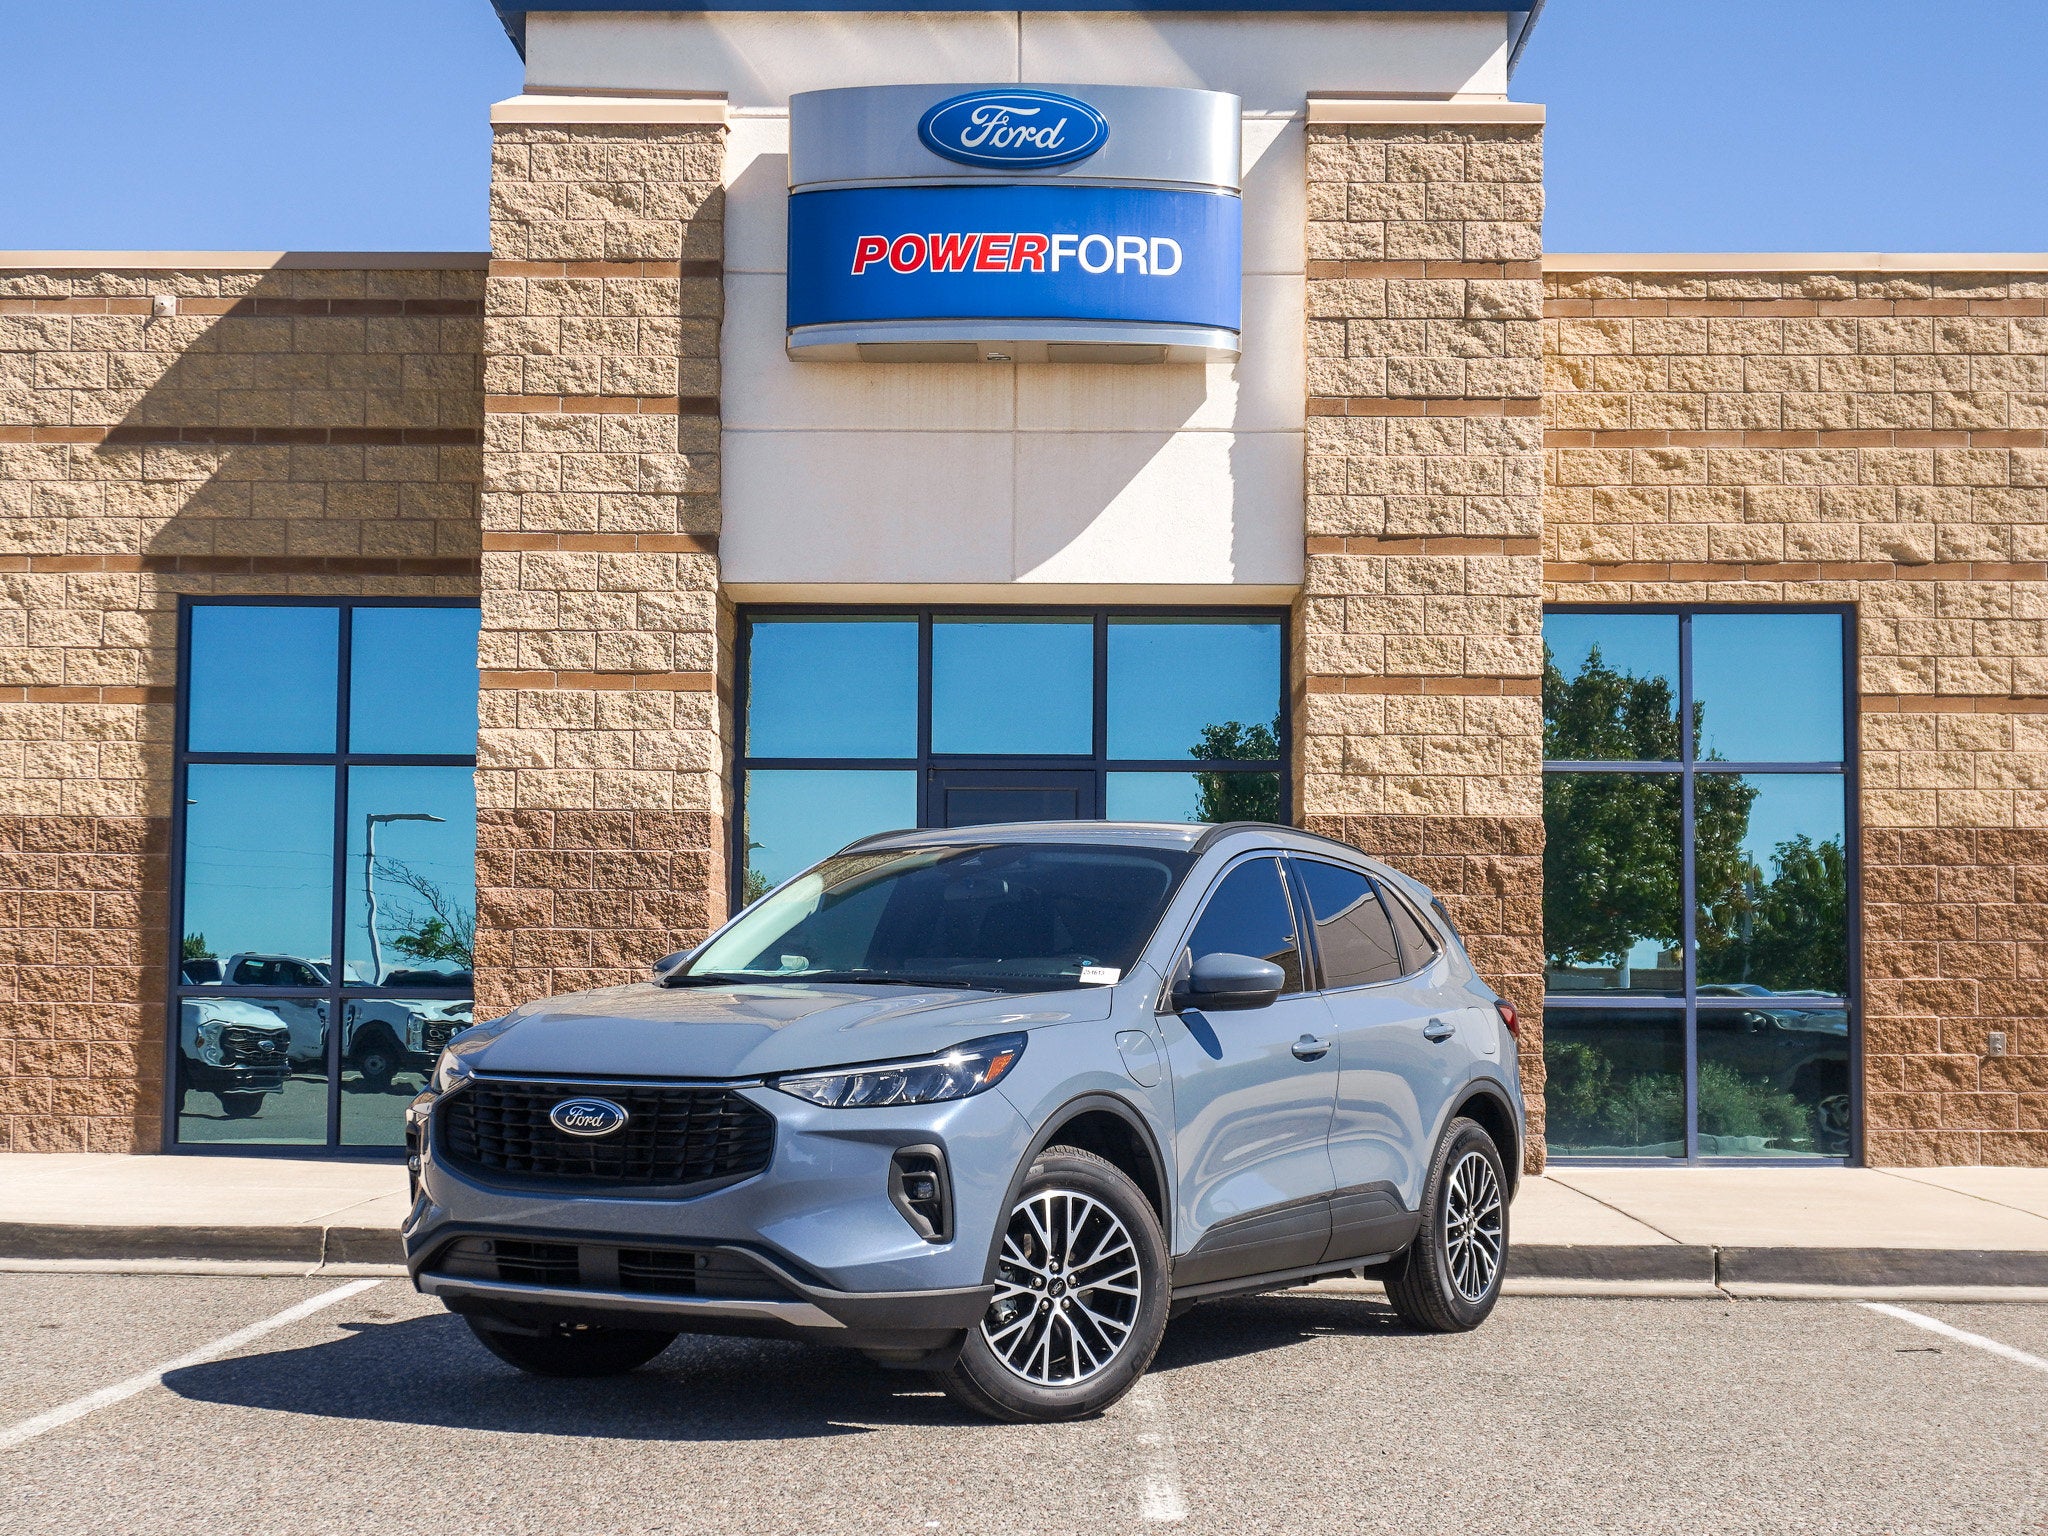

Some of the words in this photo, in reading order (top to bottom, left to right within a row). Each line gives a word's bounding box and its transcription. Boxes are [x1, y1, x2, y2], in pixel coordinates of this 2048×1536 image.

[960, 105, 1068, 149] Ford
[851, 233, 1184, 276] POWERFORD
[565, 1105, 605, 1127] Ford
